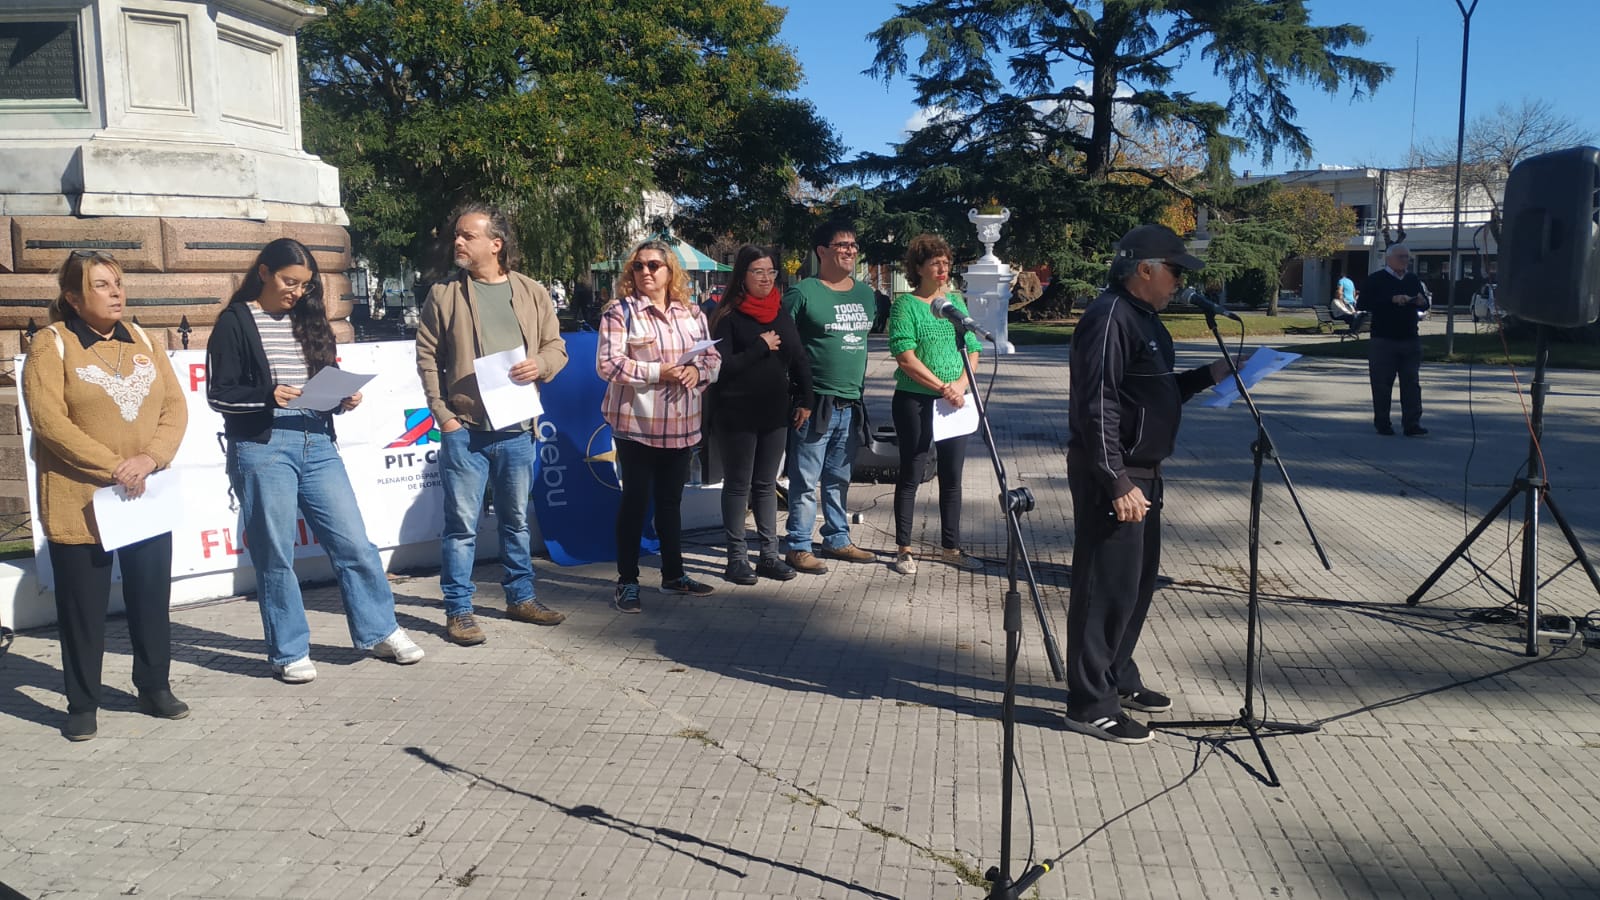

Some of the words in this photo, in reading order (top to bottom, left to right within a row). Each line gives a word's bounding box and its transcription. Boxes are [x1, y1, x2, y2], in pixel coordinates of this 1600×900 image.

[833, 303, 864, 314] TODOS
[835, 312, 868, 322] SOMOS
[384, 450, 440, 469] PIT-C
[538, 421, 567, 507] aebu
[377, 475, 413, 484] PLENARIO
[415, 472, 439, 481] DEPAR
